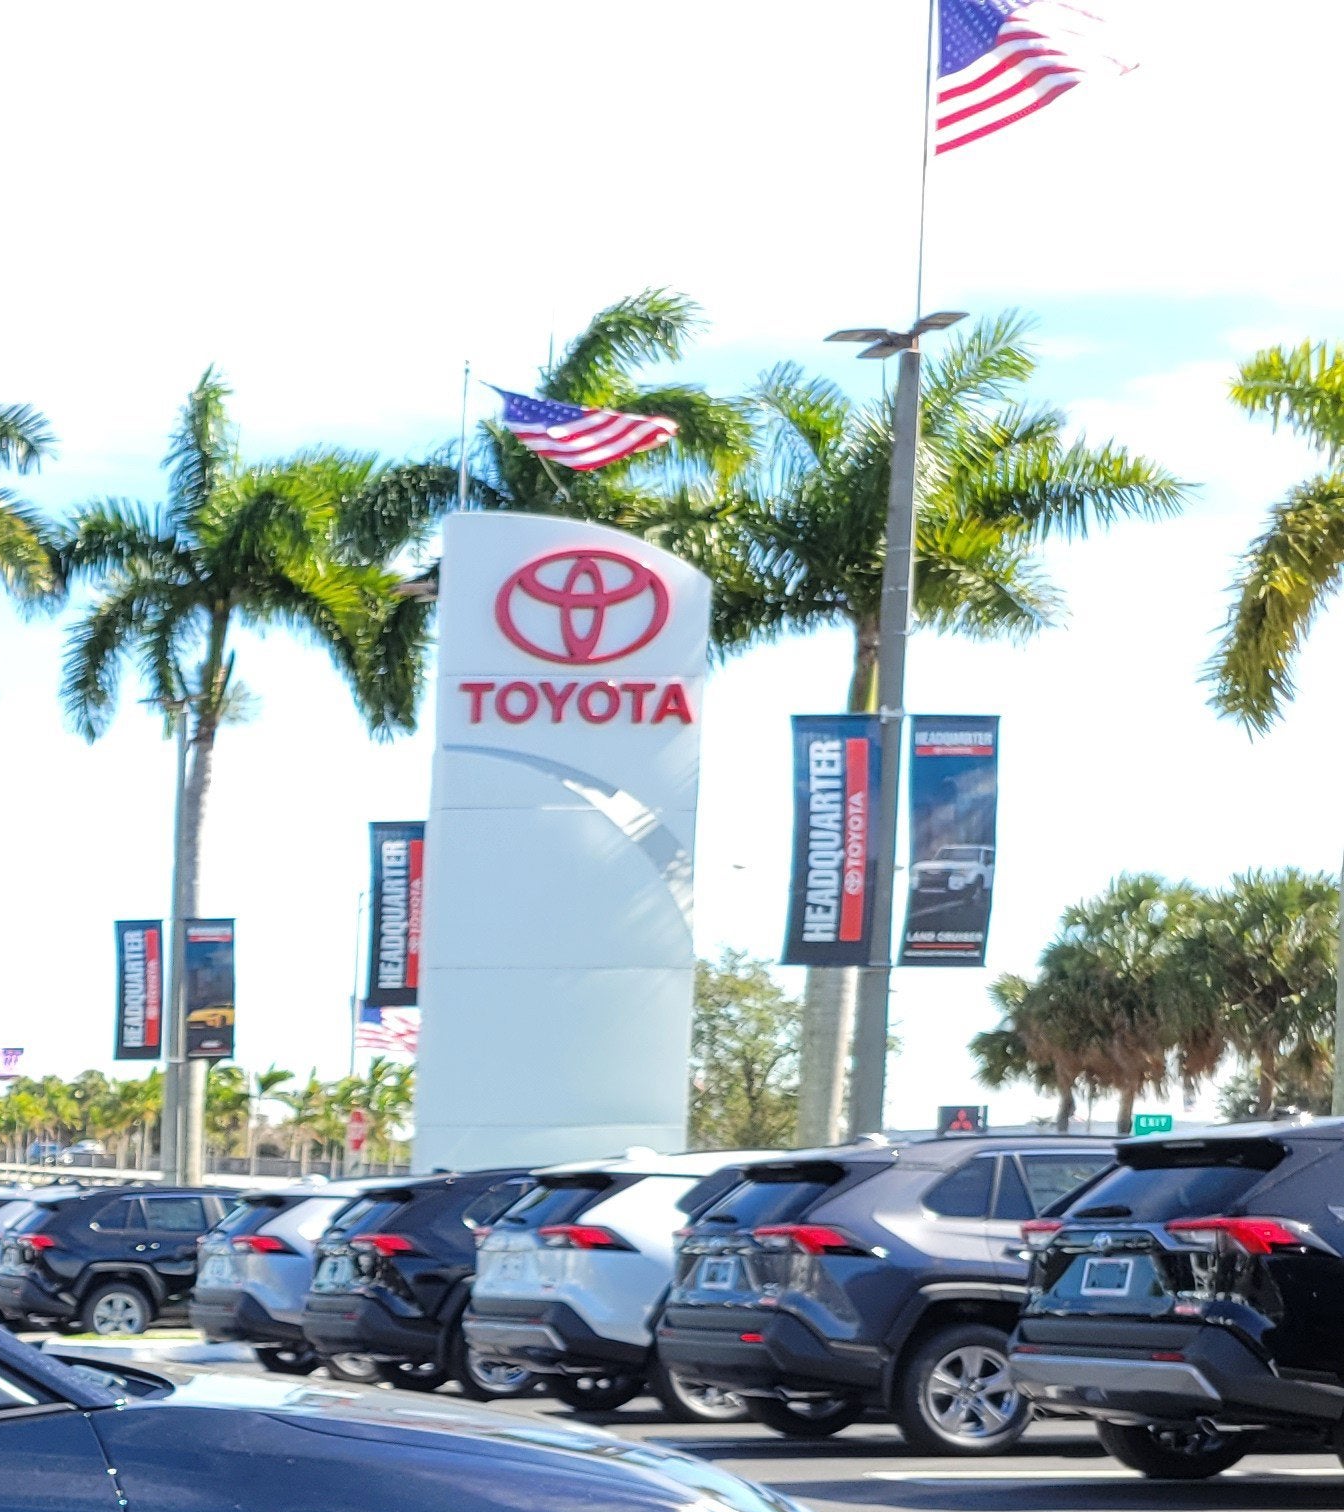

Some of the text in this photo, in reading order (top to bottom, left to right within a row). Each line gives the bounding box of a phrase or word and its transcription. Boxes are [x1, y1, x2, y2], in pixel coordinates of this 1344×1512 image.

[460, 681, 693, 724] TOYOTA
[802, 739, 845, 943] HEADQUARTER
[846, 791, 866, 870] TOYOTA
[378, 840, 409, 989] HEADQUARTER
[123, 929, 146, 1047] HEADQUARTER
[1139, 1117, 1167, 1128] EXIT
